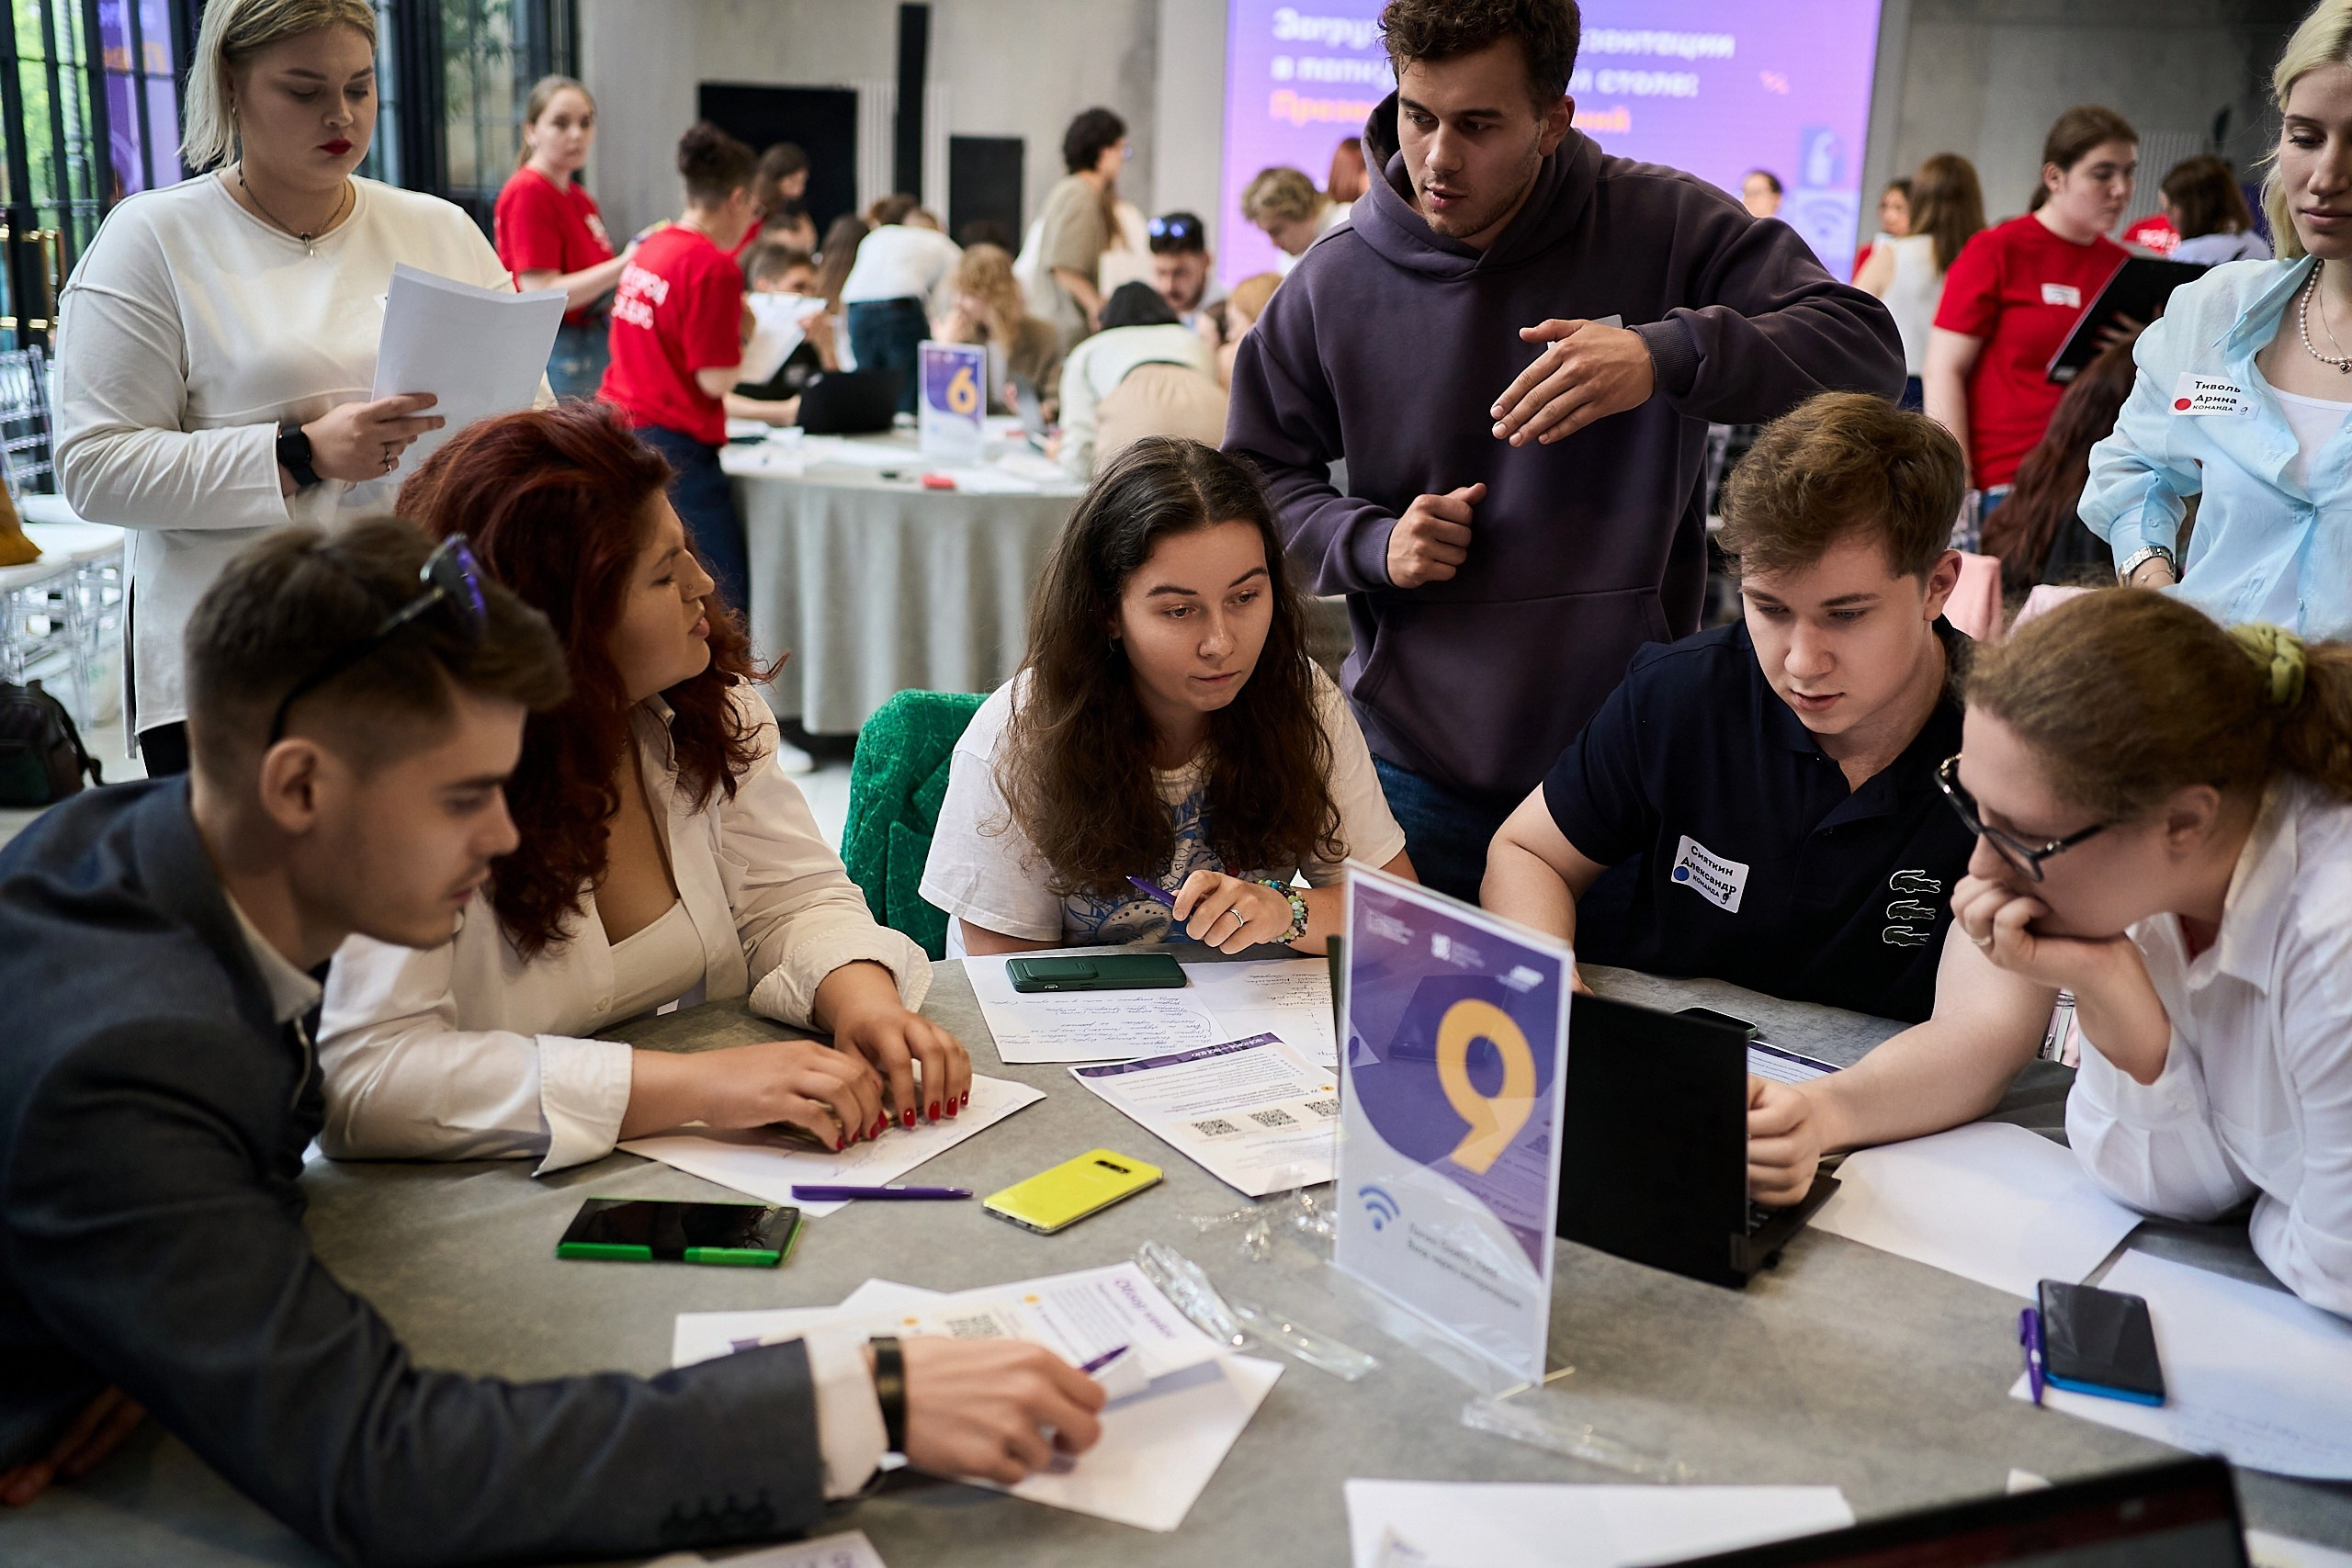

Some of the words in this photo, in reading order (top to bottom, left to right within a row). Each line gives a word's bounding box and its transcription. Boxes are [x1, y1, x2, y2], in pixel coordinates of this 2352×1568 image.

[946, 367, 978, 415] 6
[2194, 394, 2237, 404] Арина
[2195, 380, 2241, 392] Тиволь
[1680, 856, 1737, 895] Александр
[1436, 998, 1537, 1176] 9
